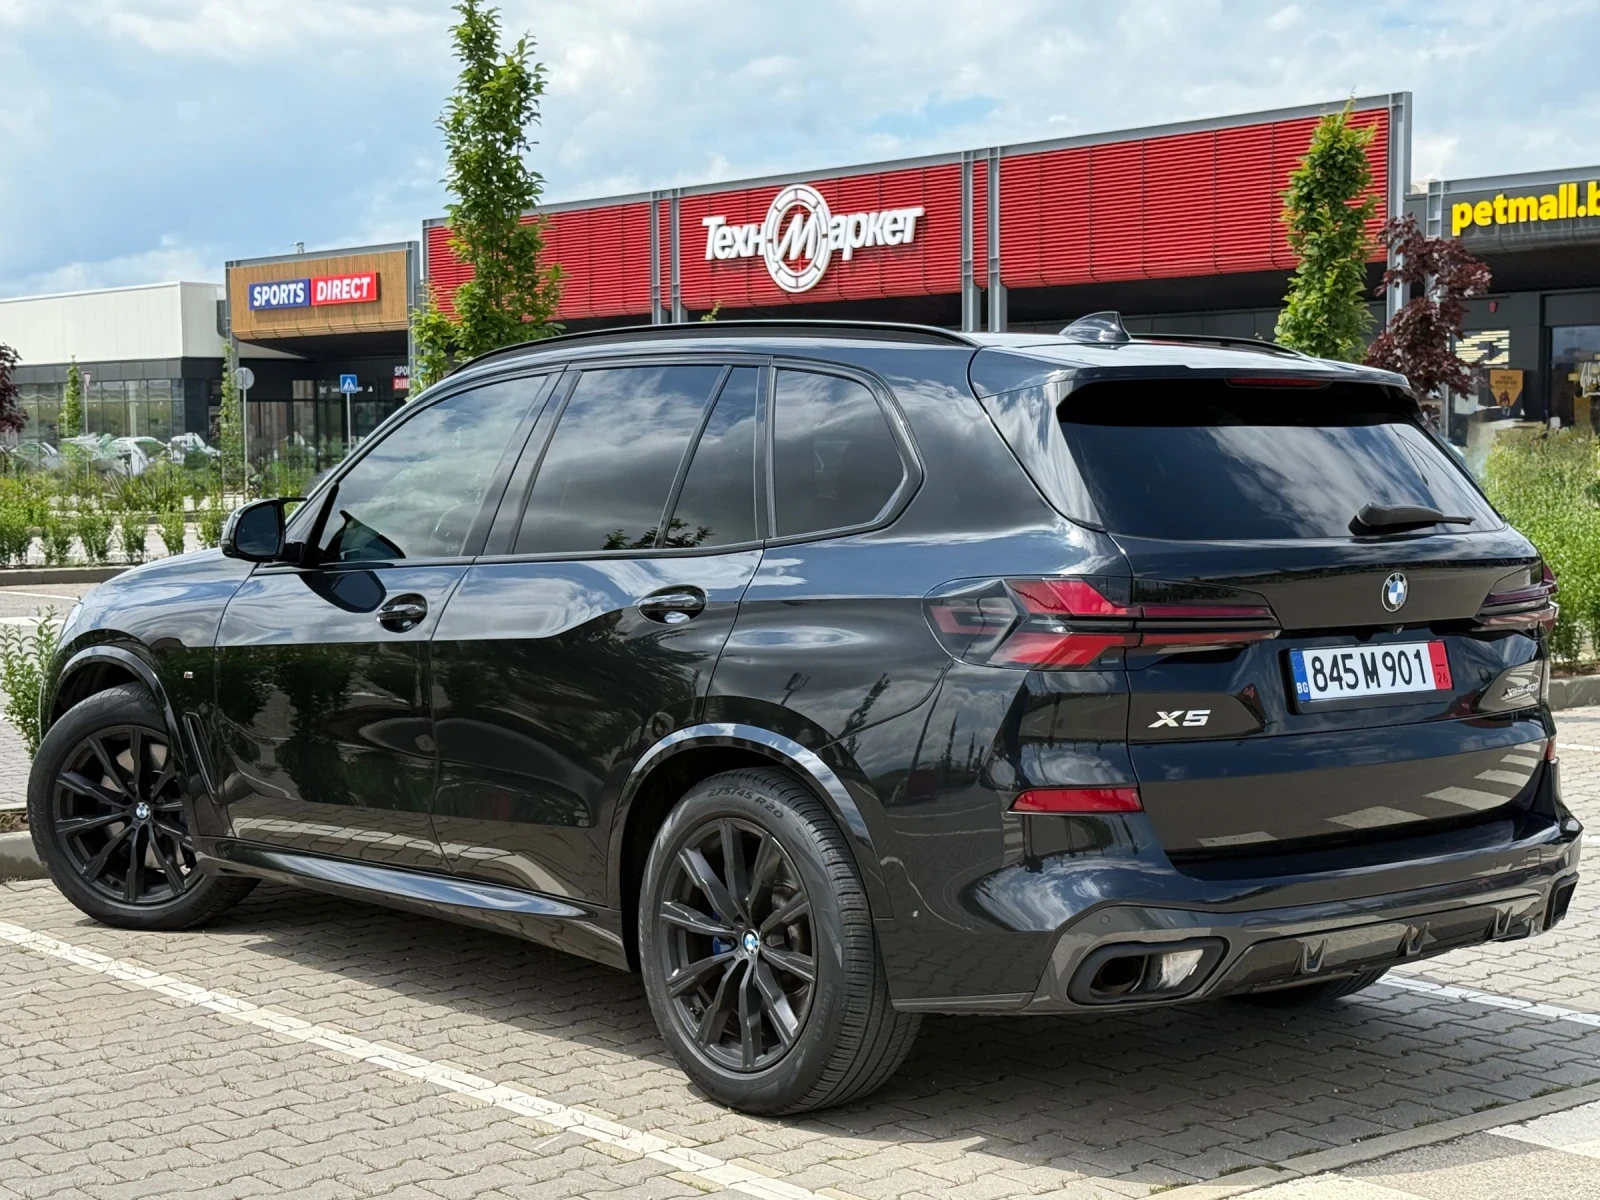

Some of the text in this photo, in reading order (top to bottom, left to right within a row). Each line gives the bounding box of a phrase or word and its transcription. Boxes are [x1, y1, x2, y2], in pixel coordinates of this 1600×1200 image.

[253, 277, 371, 307] SPORTS DIRECT
[1296, 682, 1308, 694] BG
[1147, 709, 1211, 728] X5
[708, 787, 755, 799] 275/45
[755, 796, 784, 819] R20
